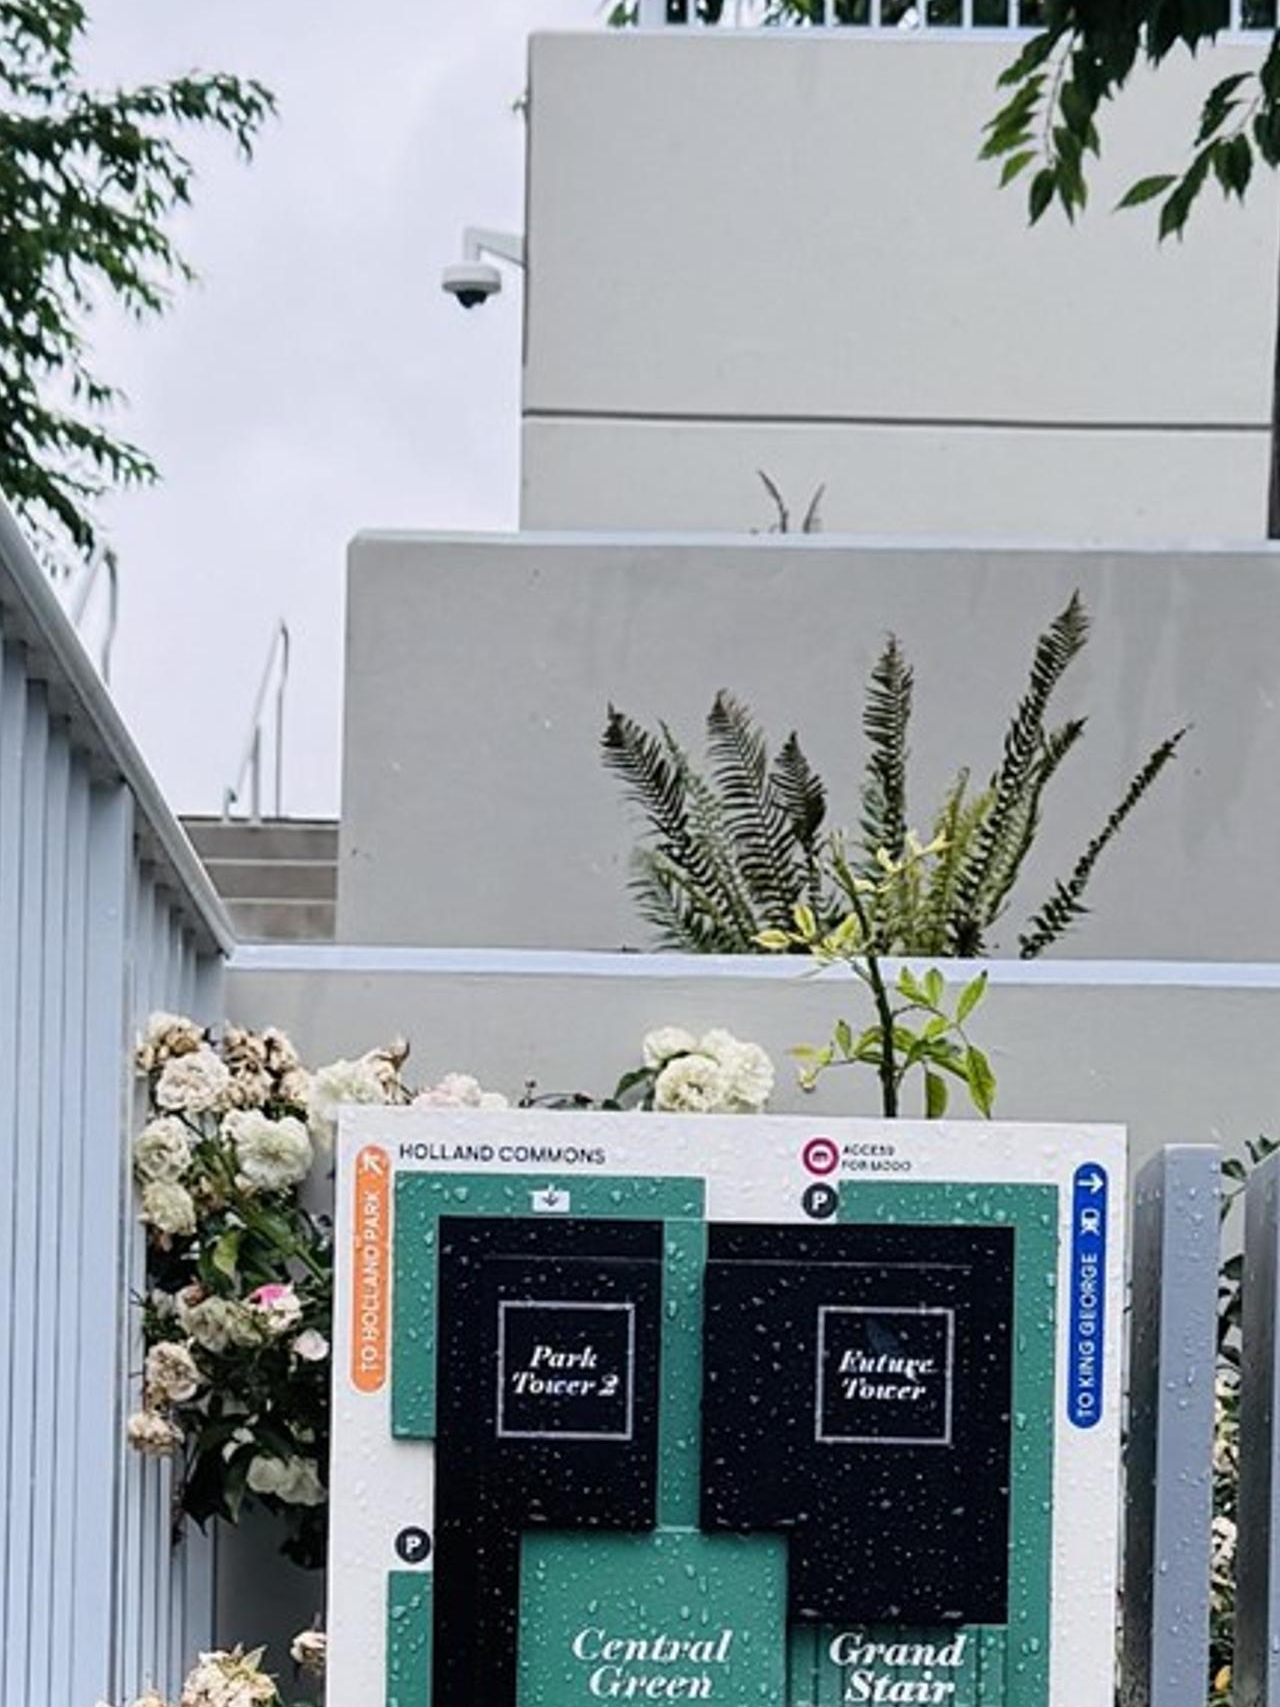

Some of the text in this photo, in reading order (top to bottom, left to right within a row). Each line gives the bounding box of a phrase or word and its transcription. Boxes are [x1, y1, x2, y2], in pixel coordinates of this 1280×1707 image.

[398, 1143, 606, 1165] HOLLAND COMMONS
[361, 1191, 381, 1373] TO HOLLAND PARK
[1077, 1253, 1098, 1419] TO KING GEORGE
[529, 1345, 598, 1369] Park
[838, 1349, 939, 1384] Future
[511, 1371, 620, 1397] Tower 2
[840, 1377, 927, 1400] Tower
[571, 1626, 734, 1664] Central
[828, 1631, 966, 1667] Grand
[588, 1664, 714, 1700] Green
[843, 1668, 957, 1705] Stair
